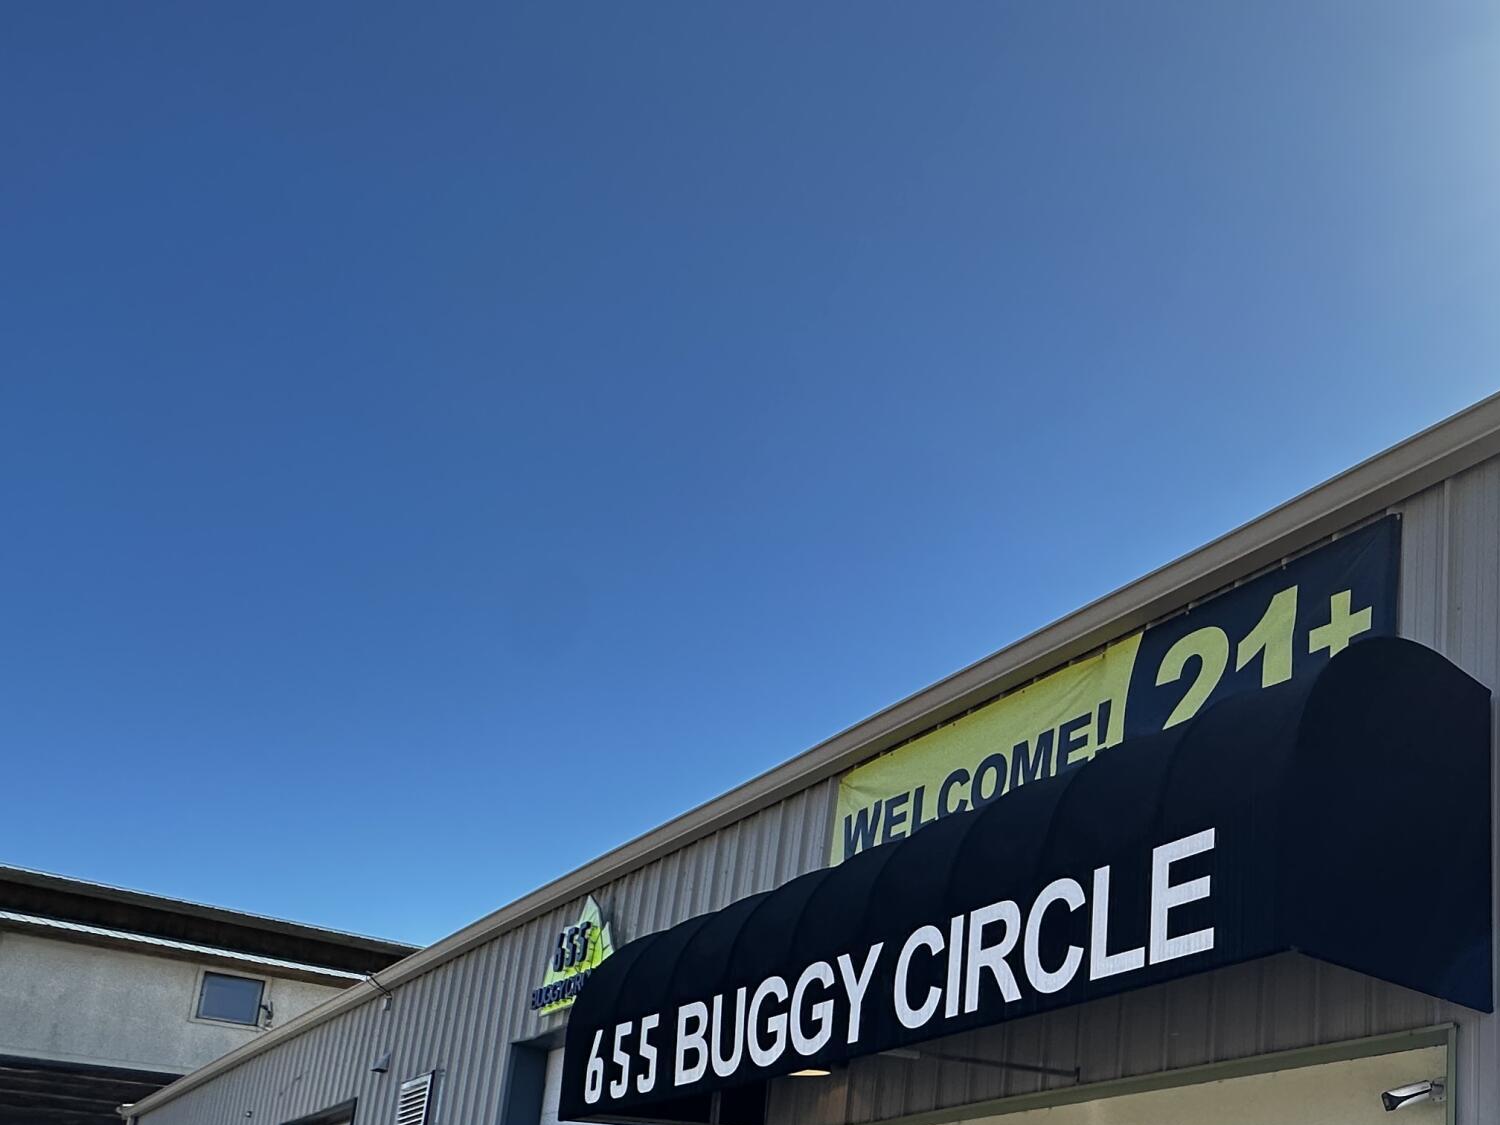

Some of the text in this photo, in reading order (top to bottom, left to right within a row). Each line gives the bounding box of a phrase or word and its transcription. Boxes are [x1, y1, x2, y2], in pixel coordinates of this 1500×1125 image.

[1155, 585, 1373, 730] 21+
[844, 698, 1113, 862] WELCOME!
[531, 979, 567, 1010] BUGGY
[553, 921, 592, 972] 655
[584, 828, 1216, 1105] 655 BUGGY CIRCLE
